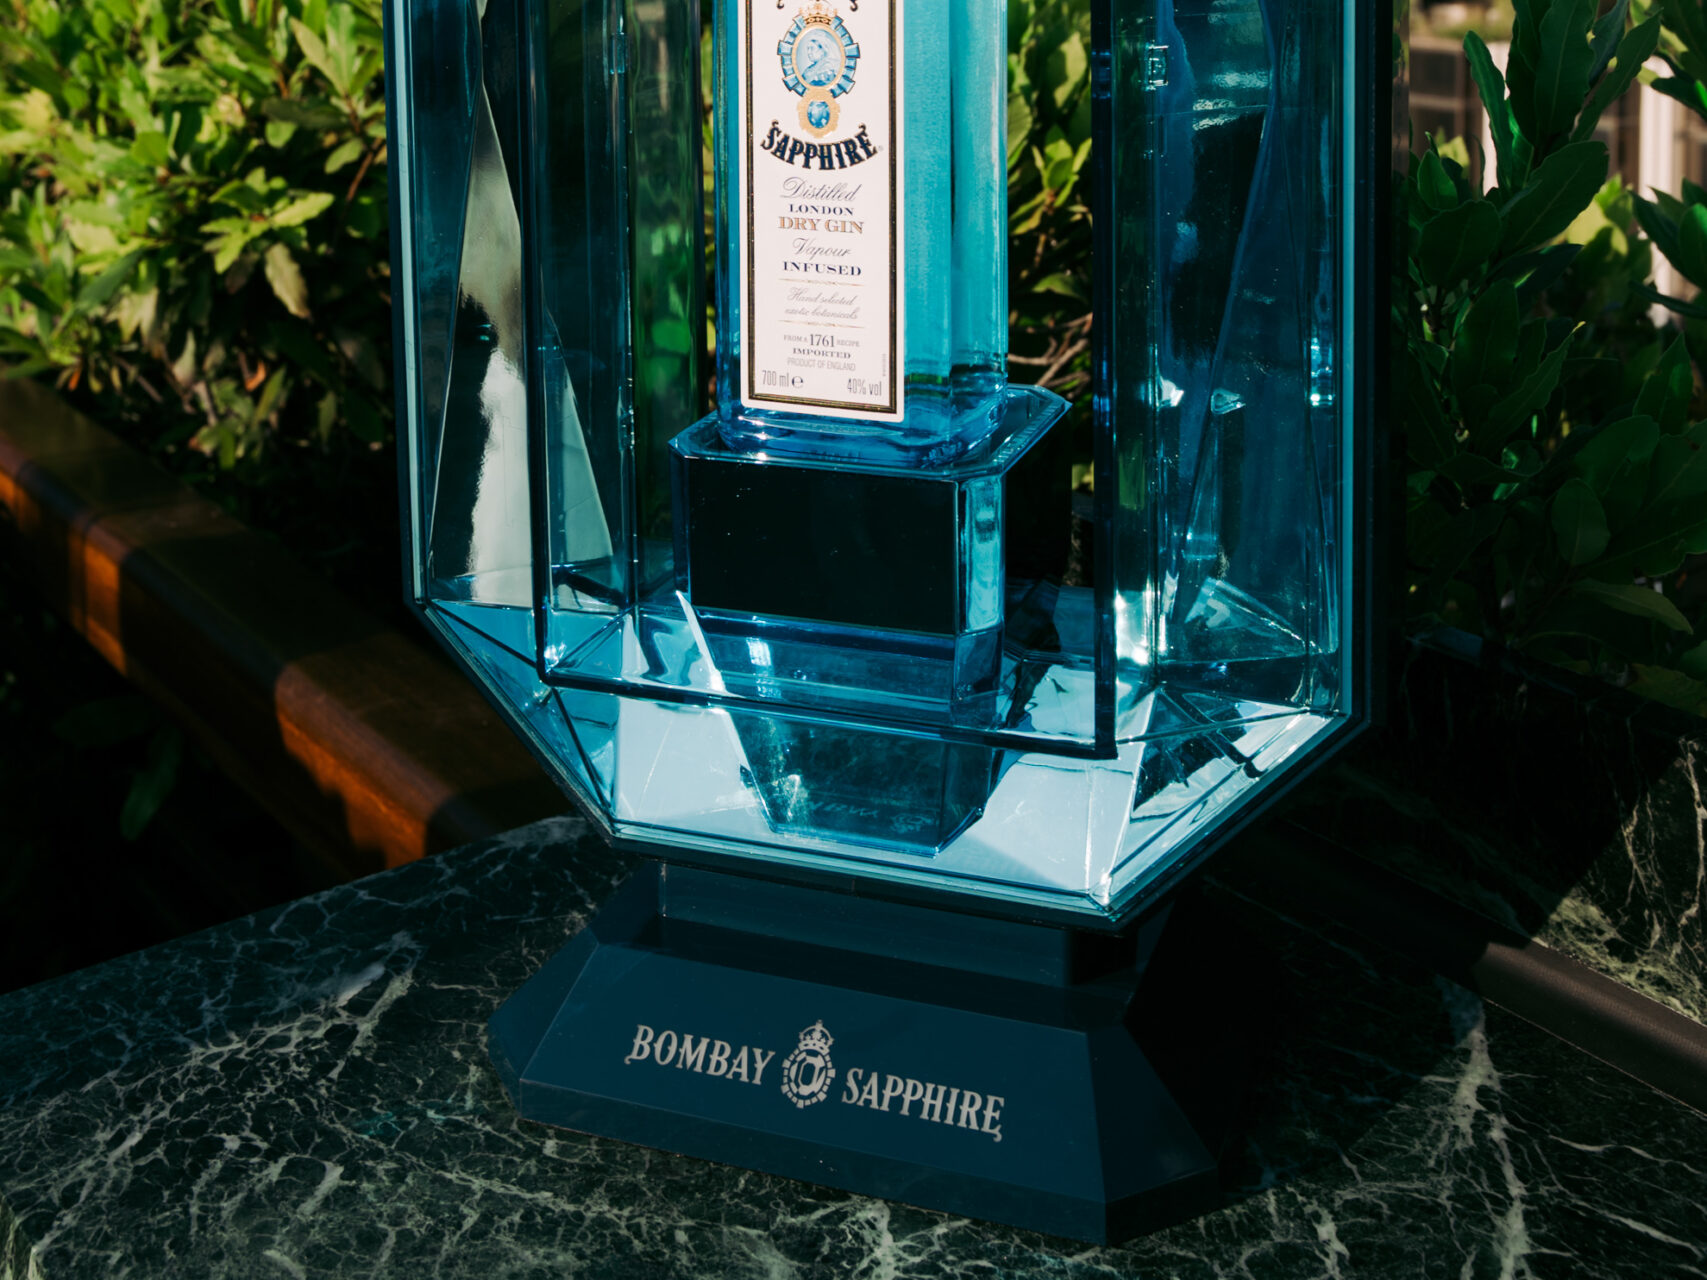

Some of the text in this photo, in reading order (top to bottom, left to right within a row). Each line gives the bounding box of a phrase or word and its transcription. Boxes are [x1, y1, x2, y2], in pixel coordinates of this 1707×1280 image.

[760, 119, 878, 170] SAPPHIRE
[780, 176, 863, 202] Distilled
[789, 203, 855, 216] LONDON
[778, 216, 864, 234] DRY GIN
[792, 237, 853, 261] Vapour
[782, 261, 862, 276] INFUSED
[809, 333, 835, 348] 1761
[792, 347, 852, 359] IMPORTED
[787, 357, 856, 372] PRODUCT OF ENGLAND
[762, 370, 777, 386] 700
[779, 372, 789, 387] ml
[847, 378, 882, 396] 40% vol
[623, 1024, 1006, 1143] BOMBAY SAPPHIRE
